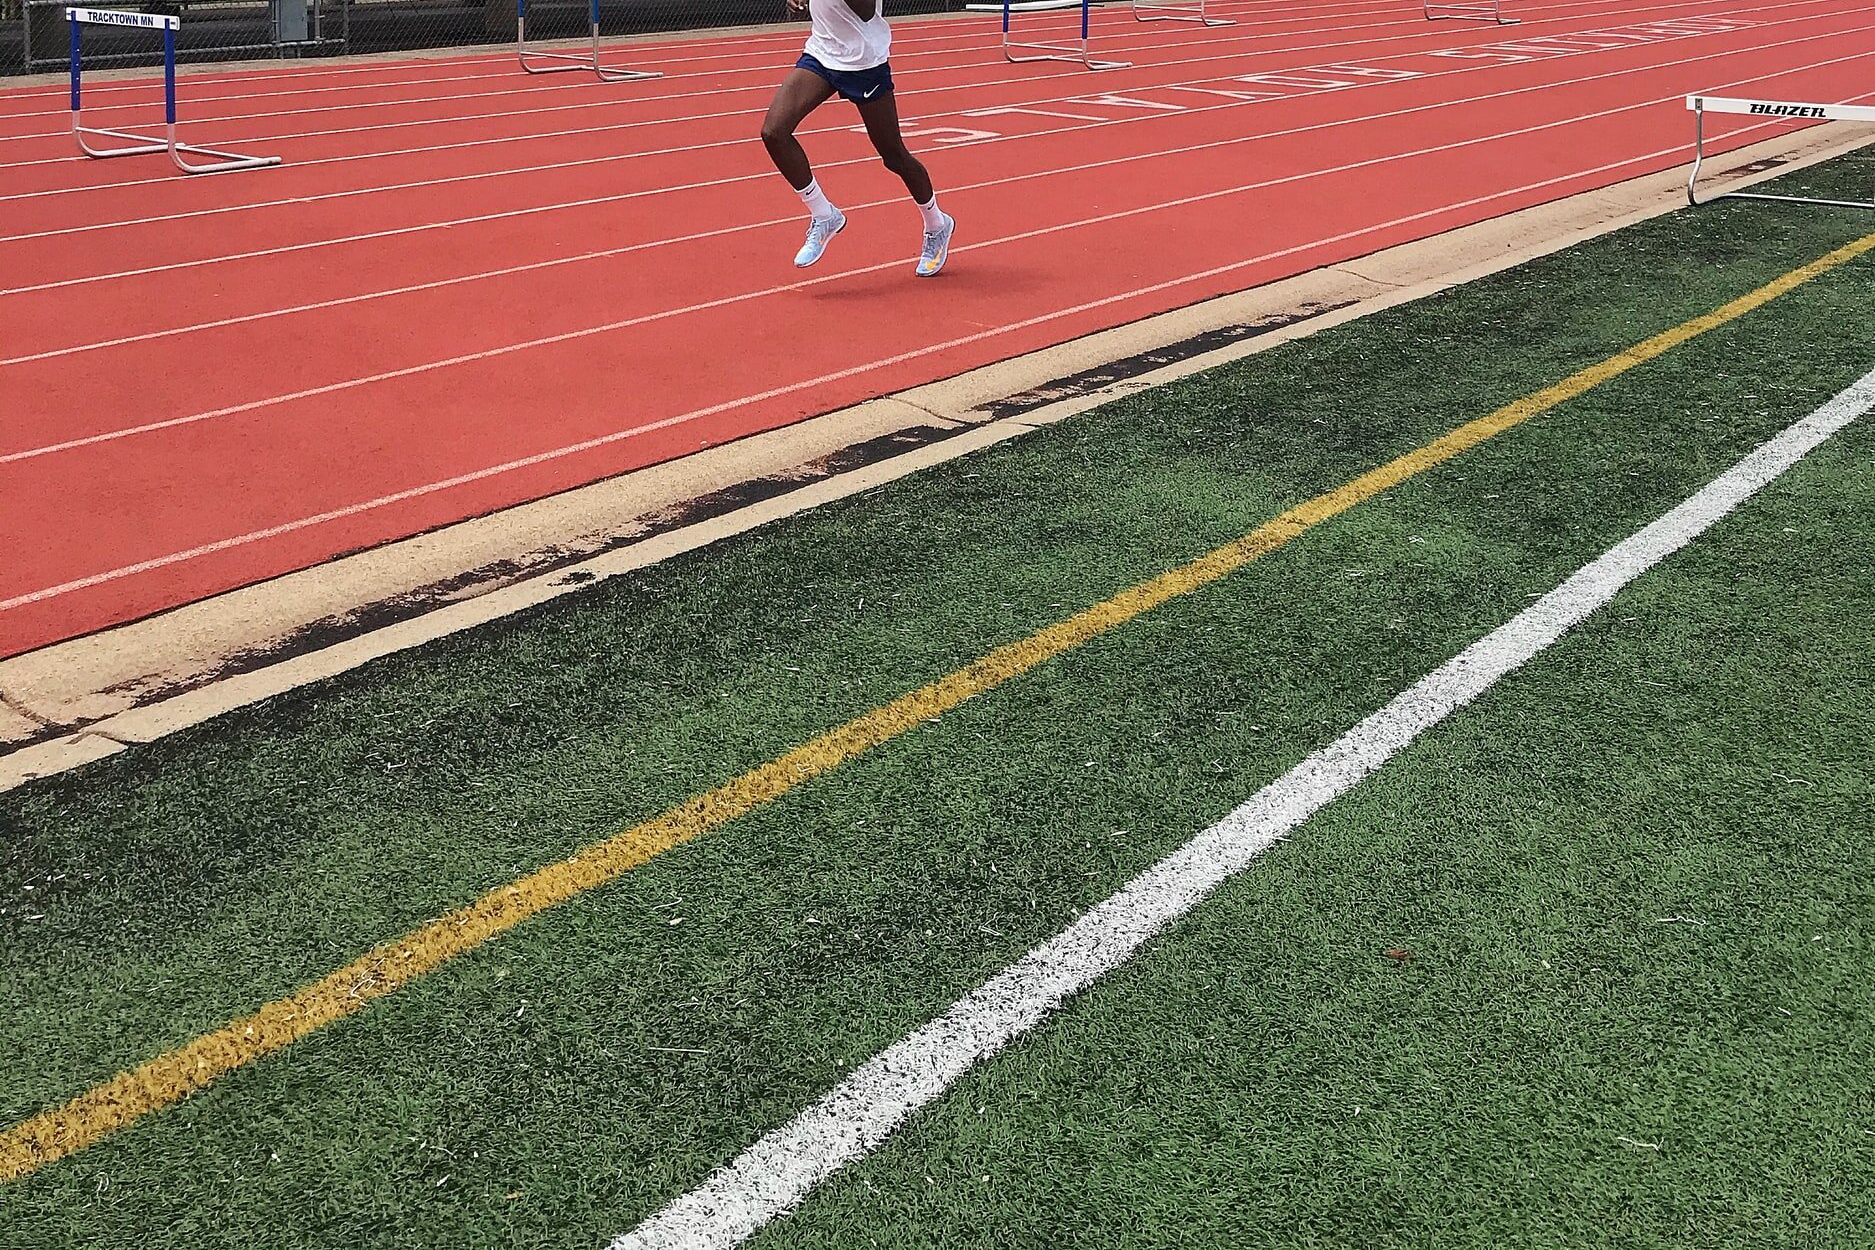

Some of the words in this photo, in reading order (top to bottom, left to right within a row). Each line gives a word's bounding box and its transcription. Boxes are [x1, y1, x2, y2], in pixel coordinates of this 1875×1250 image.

[87, 11, 139, 25] TRACKTOWN
[140, 16, 154, 27] MN
[1749, 103, 1827, 118] BLAZER
